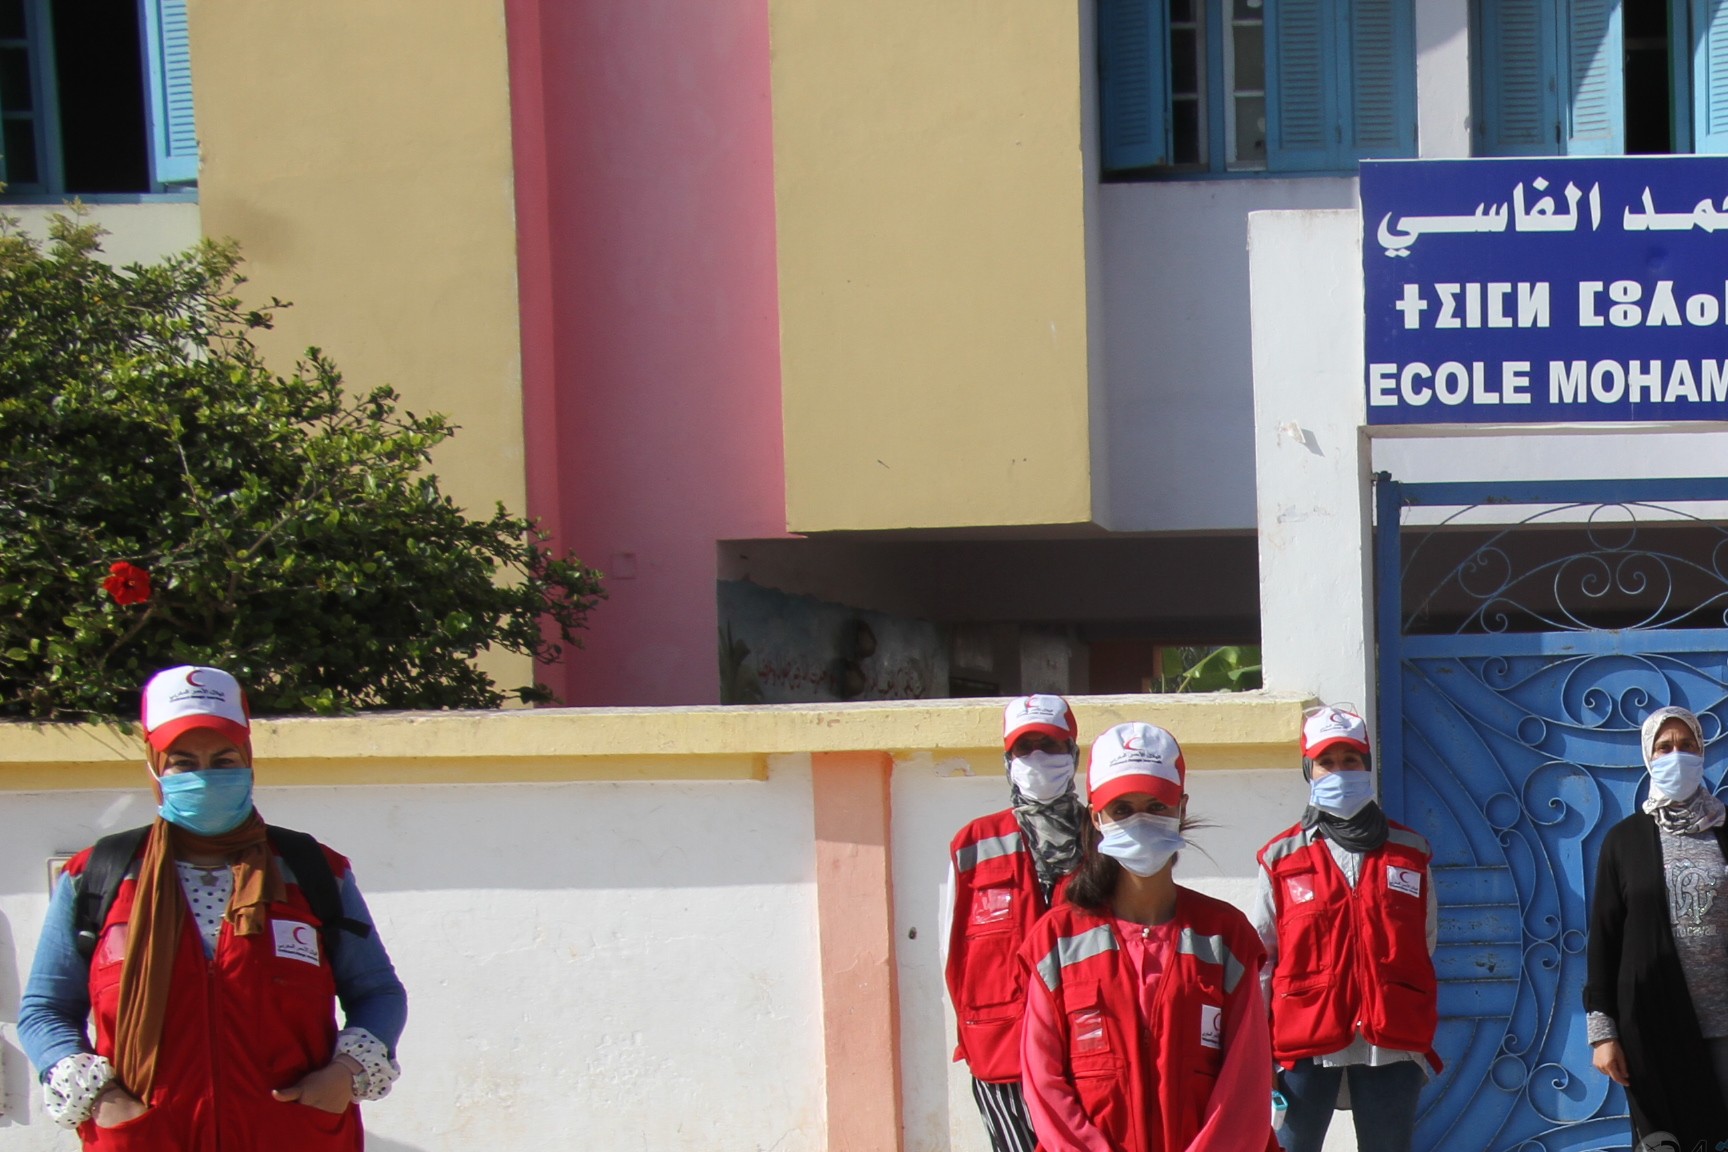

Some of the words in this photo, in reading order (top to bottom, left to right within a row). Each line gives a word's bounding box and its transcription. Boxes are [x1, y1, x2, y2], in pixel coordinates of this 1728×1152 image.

[1376, 176, 1601, 258] الفاسي
[1395, 280, 1551, 329] ⵜⵉⵏⵎⵍ
[1369, 361, 1532, 406] ECOLE
